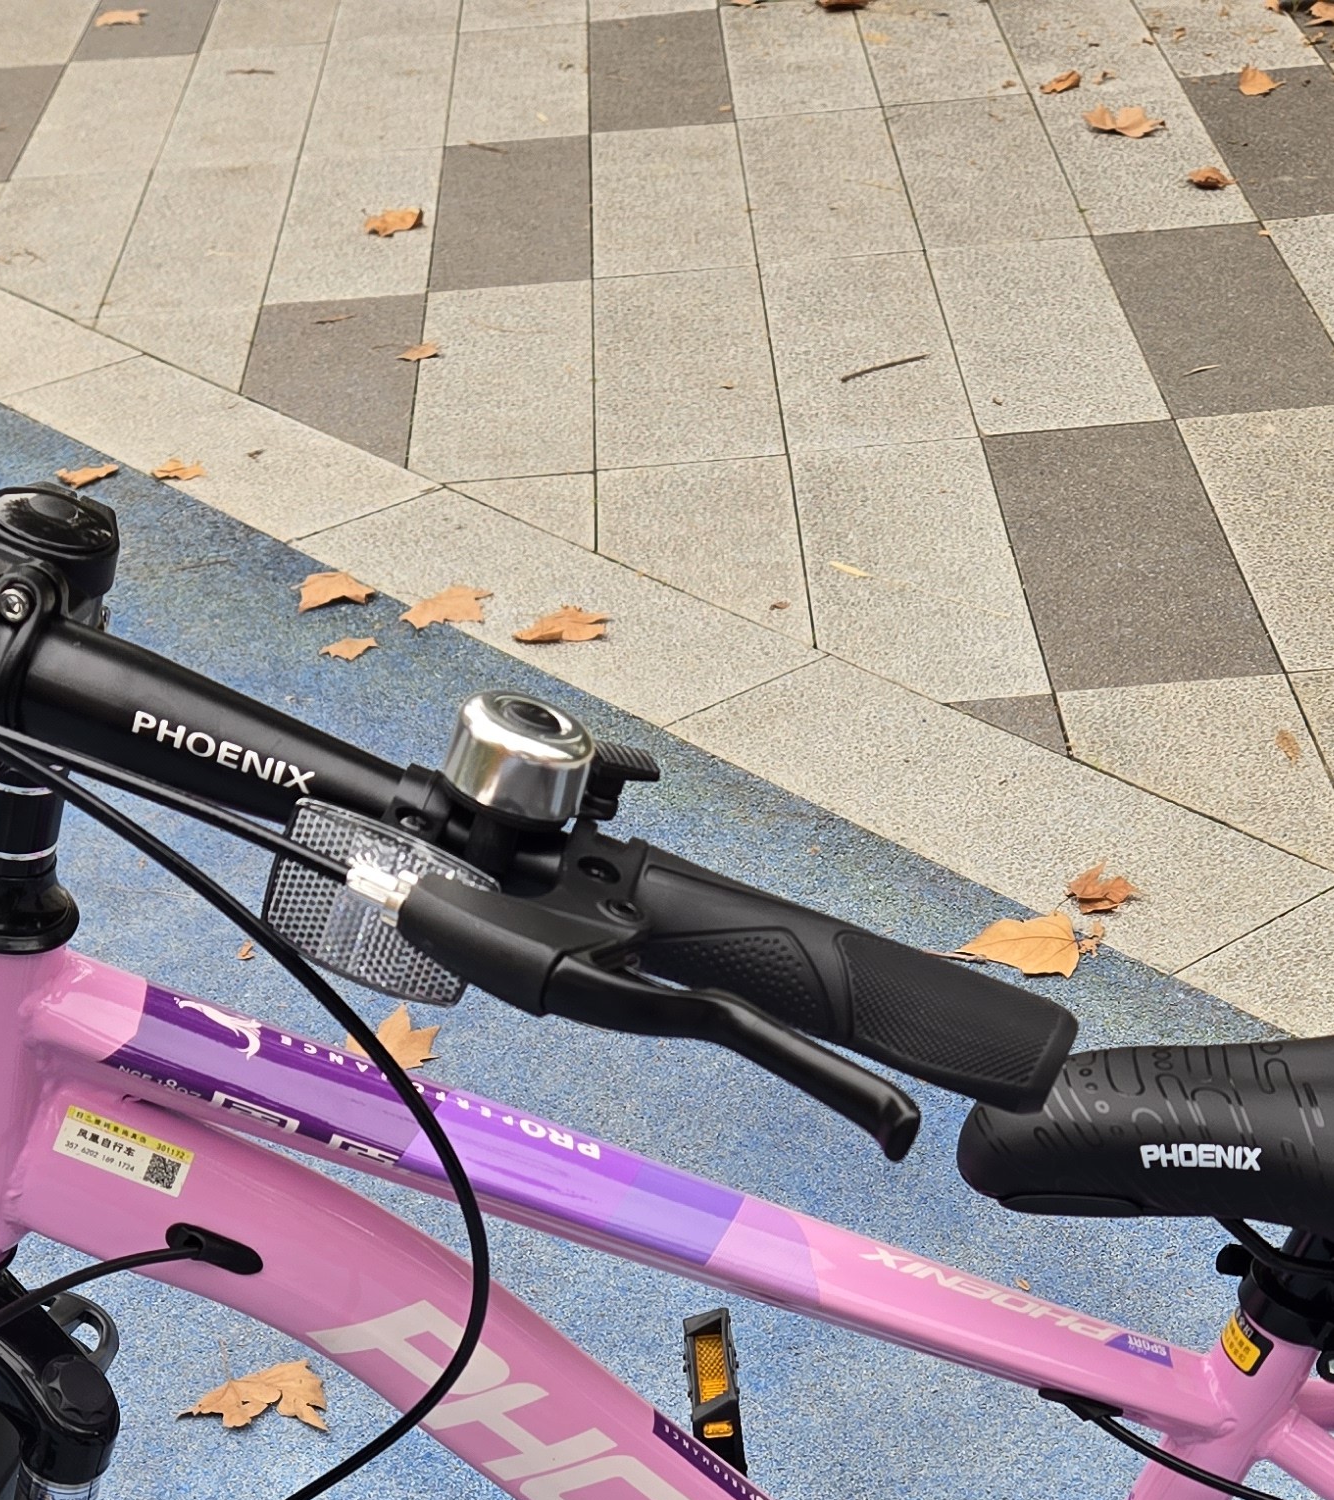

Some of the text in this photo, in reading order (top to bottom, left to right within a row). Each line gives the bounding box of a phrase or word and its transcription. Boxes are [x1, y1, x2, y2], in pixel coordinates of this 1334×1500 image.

[131, 709, 316, 795] PHOENIX
[76, 1127, 136, 1158] 凤凰自行车
[1140, 1143, 1262, 1171] PHOENIX
[858, 1246, 1119, 1341] PHOENIX
